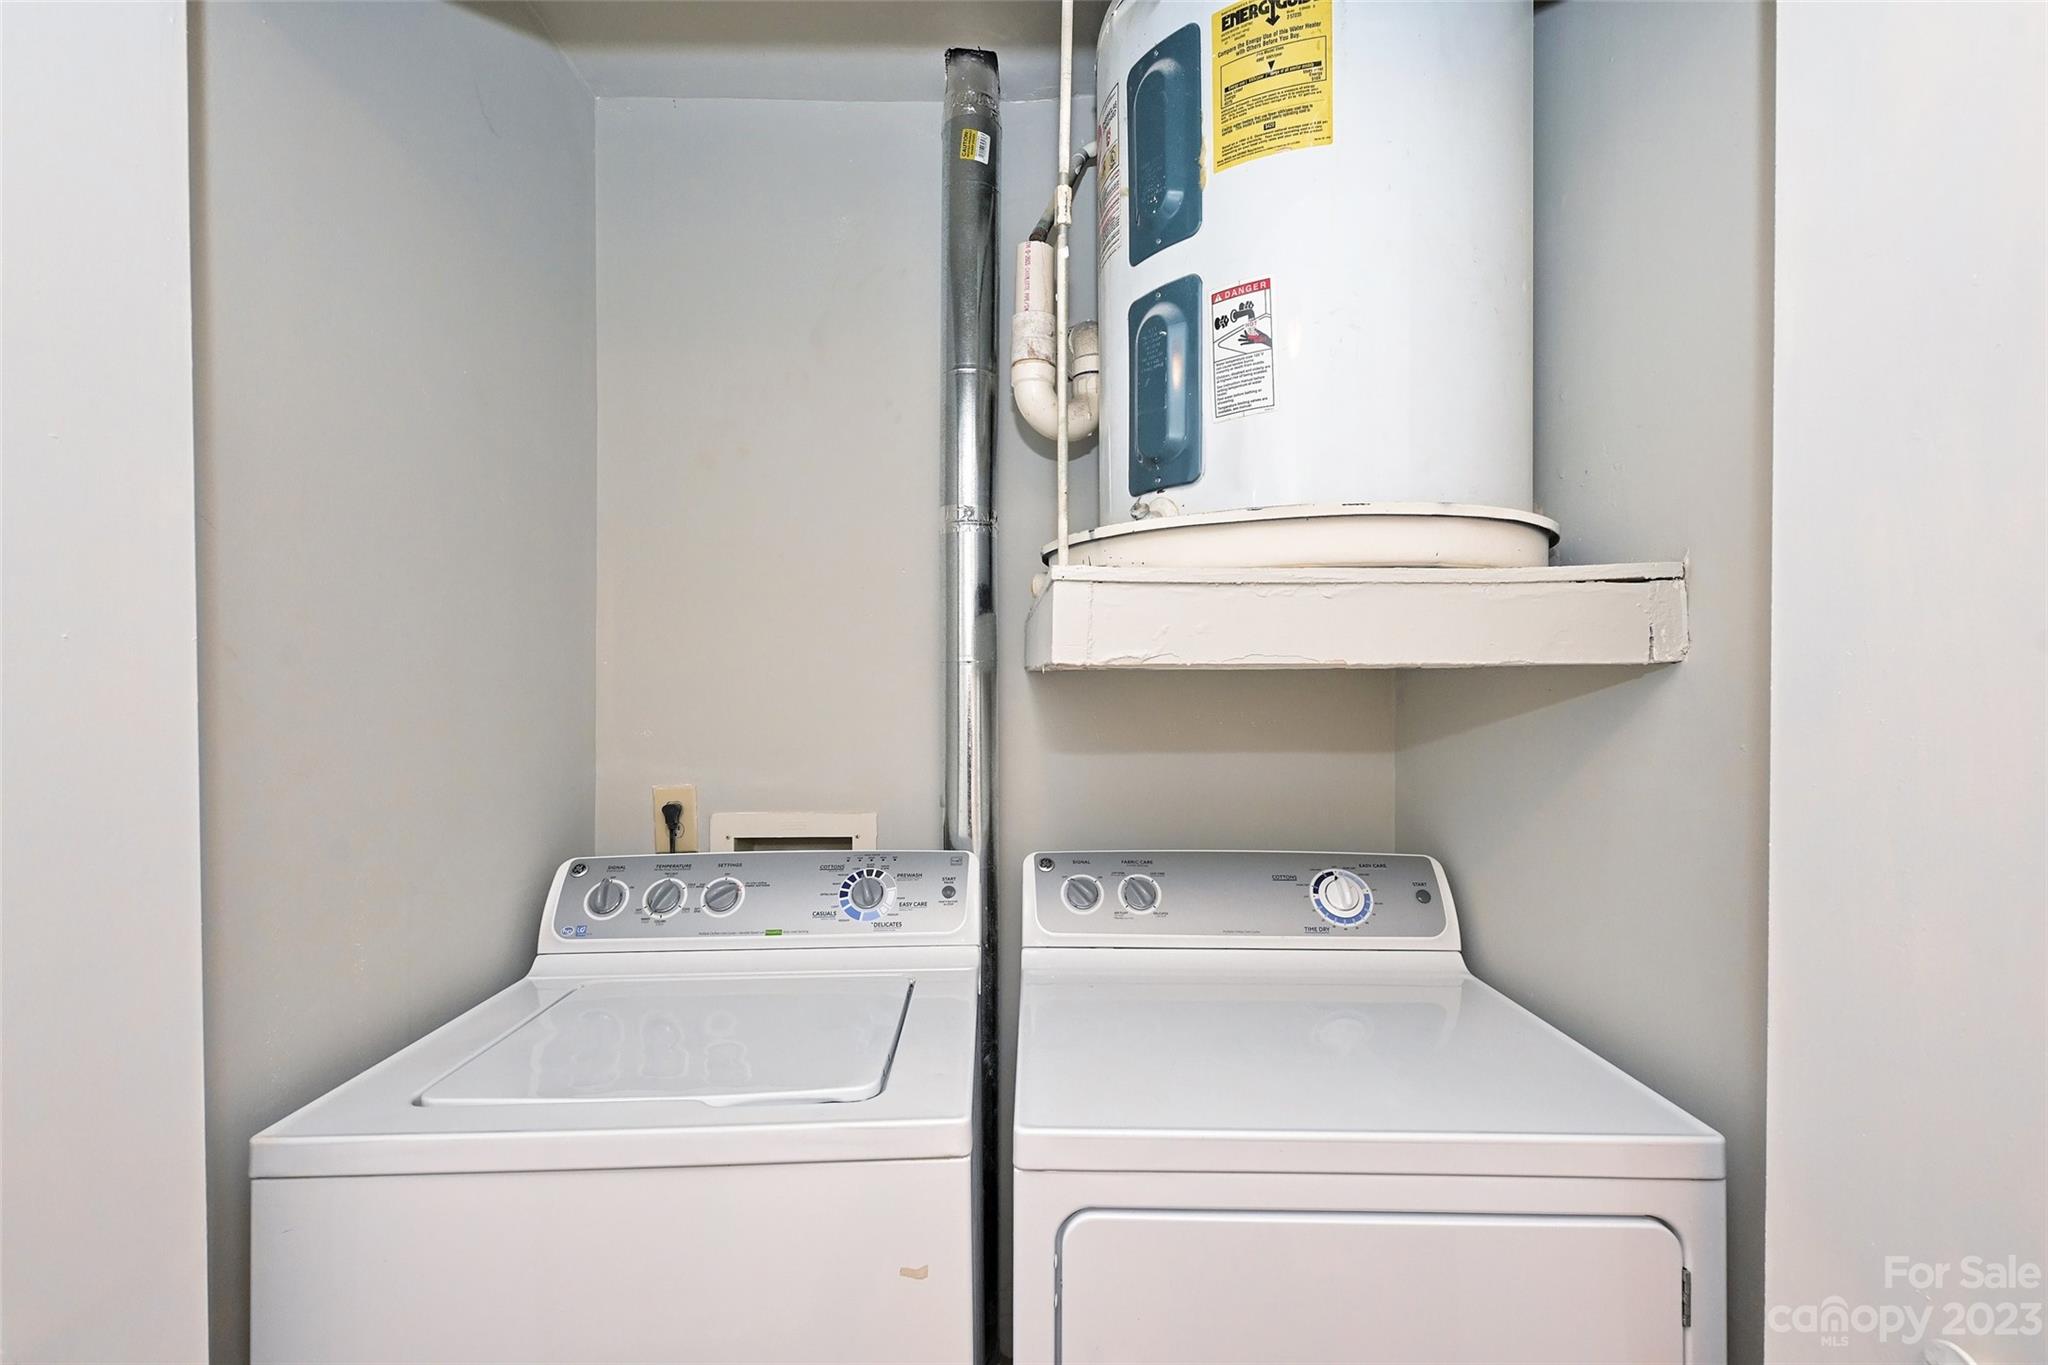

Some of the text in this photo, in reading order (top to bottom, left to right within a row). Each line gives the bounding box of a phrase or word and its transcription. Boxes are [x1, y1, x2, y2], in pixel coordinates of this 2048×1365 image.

[1245, 36, 1262, 47] Energy
[961, 131, 969, 157] CAUTION
[1224, 281, 1267, 299] DANGER
